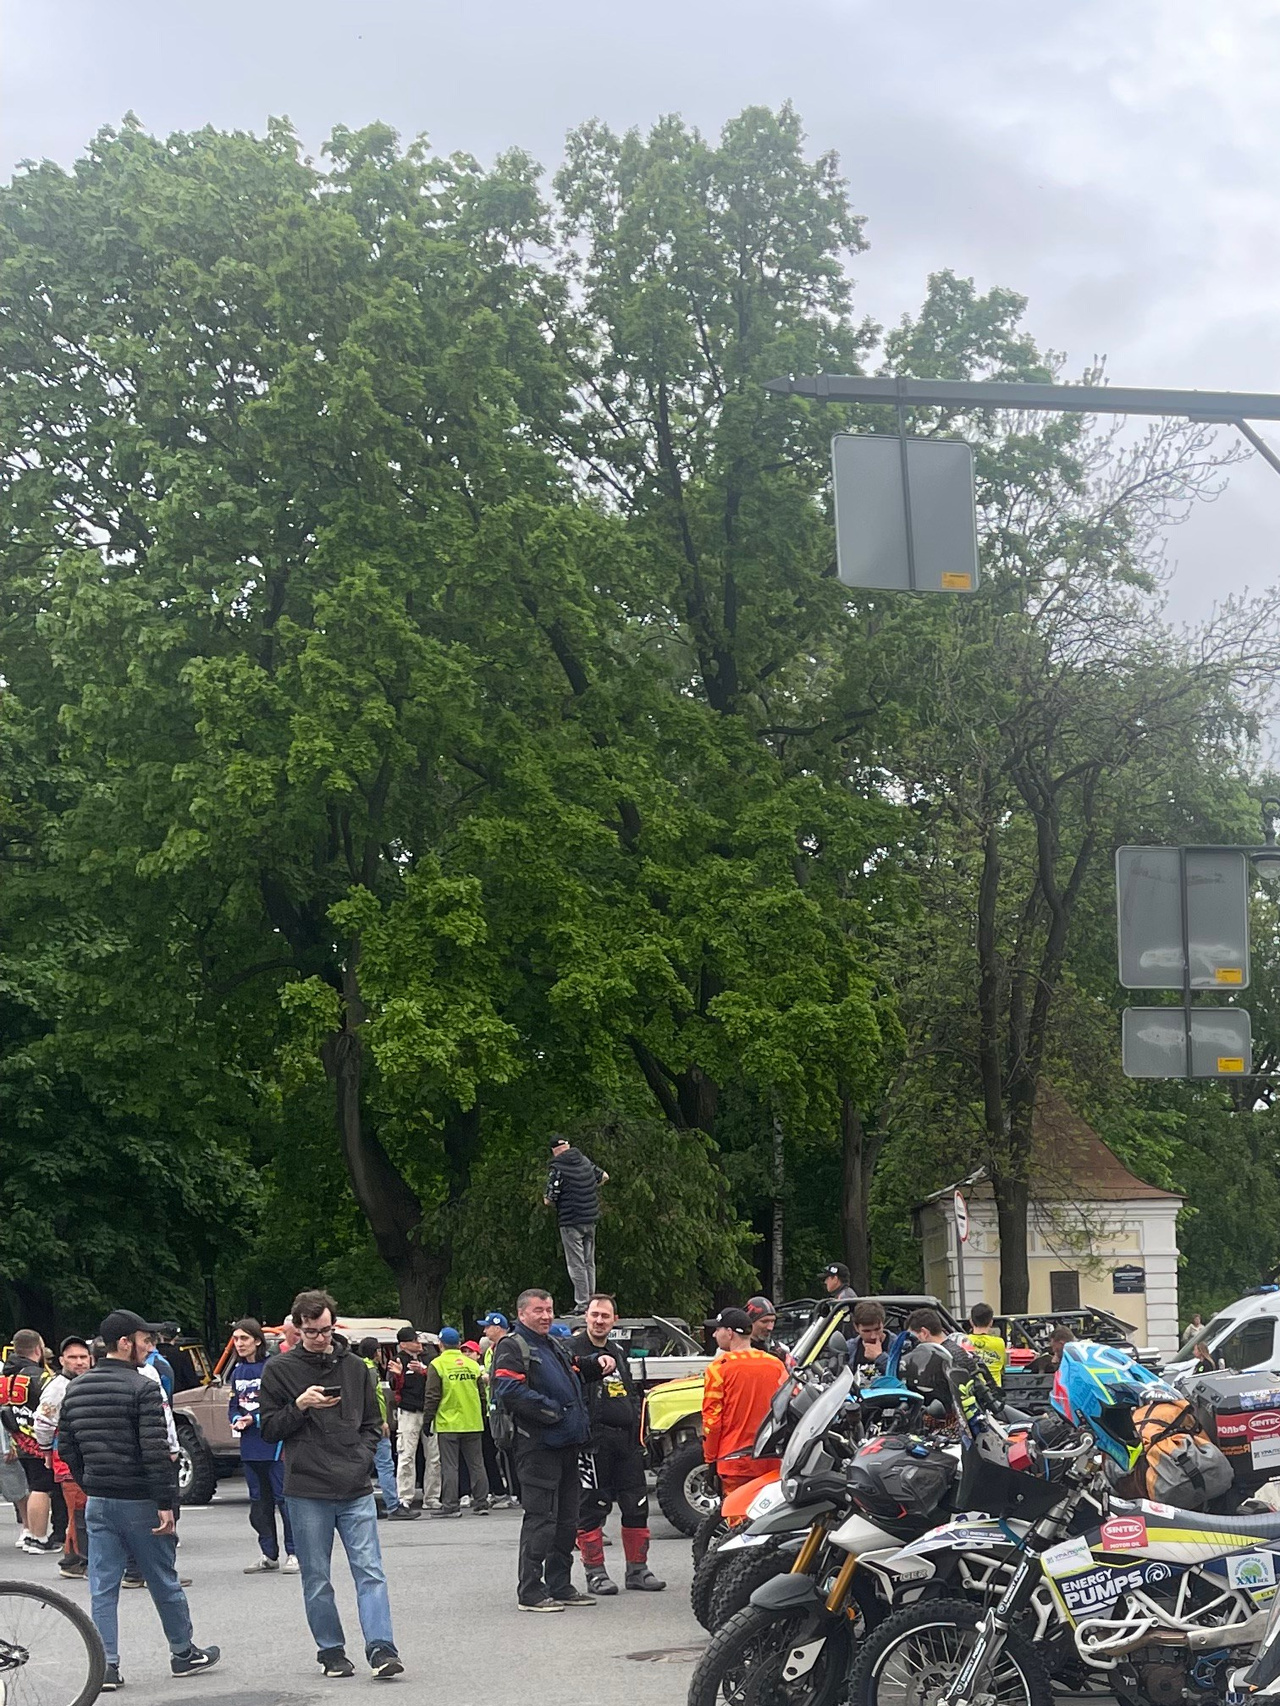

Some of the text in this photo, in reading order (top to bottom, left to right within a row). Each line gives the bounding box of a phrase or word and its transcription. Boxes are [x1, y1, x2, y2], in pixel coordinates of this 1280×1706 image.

[1106, 1525, 1140, 1534] SINTEC
[1062, 1568, 1113, 1593] ENERGY
[1063, 1569, 1144, 1608] PUMPS
